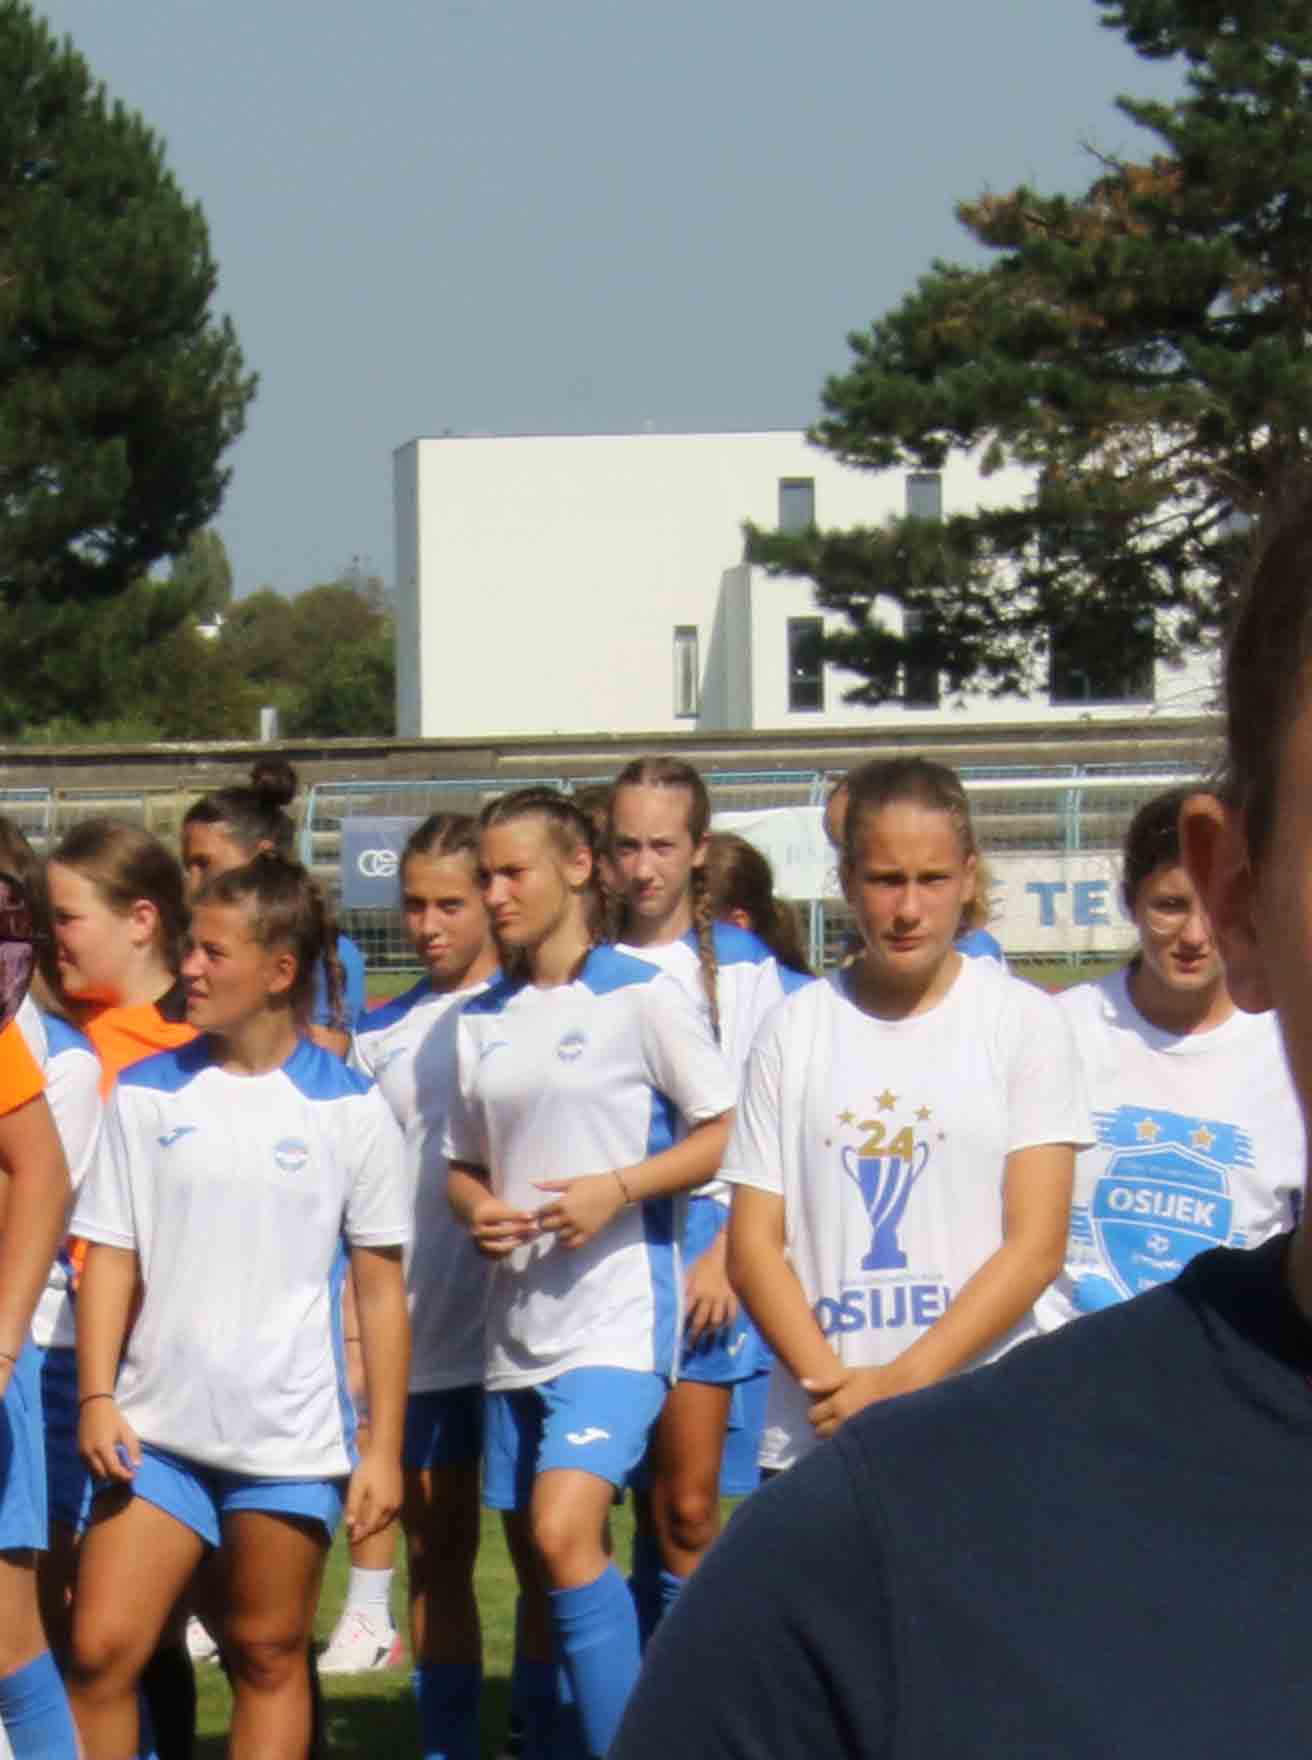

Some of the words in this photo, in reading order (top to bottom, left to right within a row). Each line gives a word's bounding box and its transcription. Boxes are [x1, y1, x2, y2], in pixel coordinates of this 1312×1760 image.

[856, 1119, 915, 1163] 24
[1107, 1186, 1217, 1229] OSIJEK
[814, 1284, 951, 1337] OSIJE
